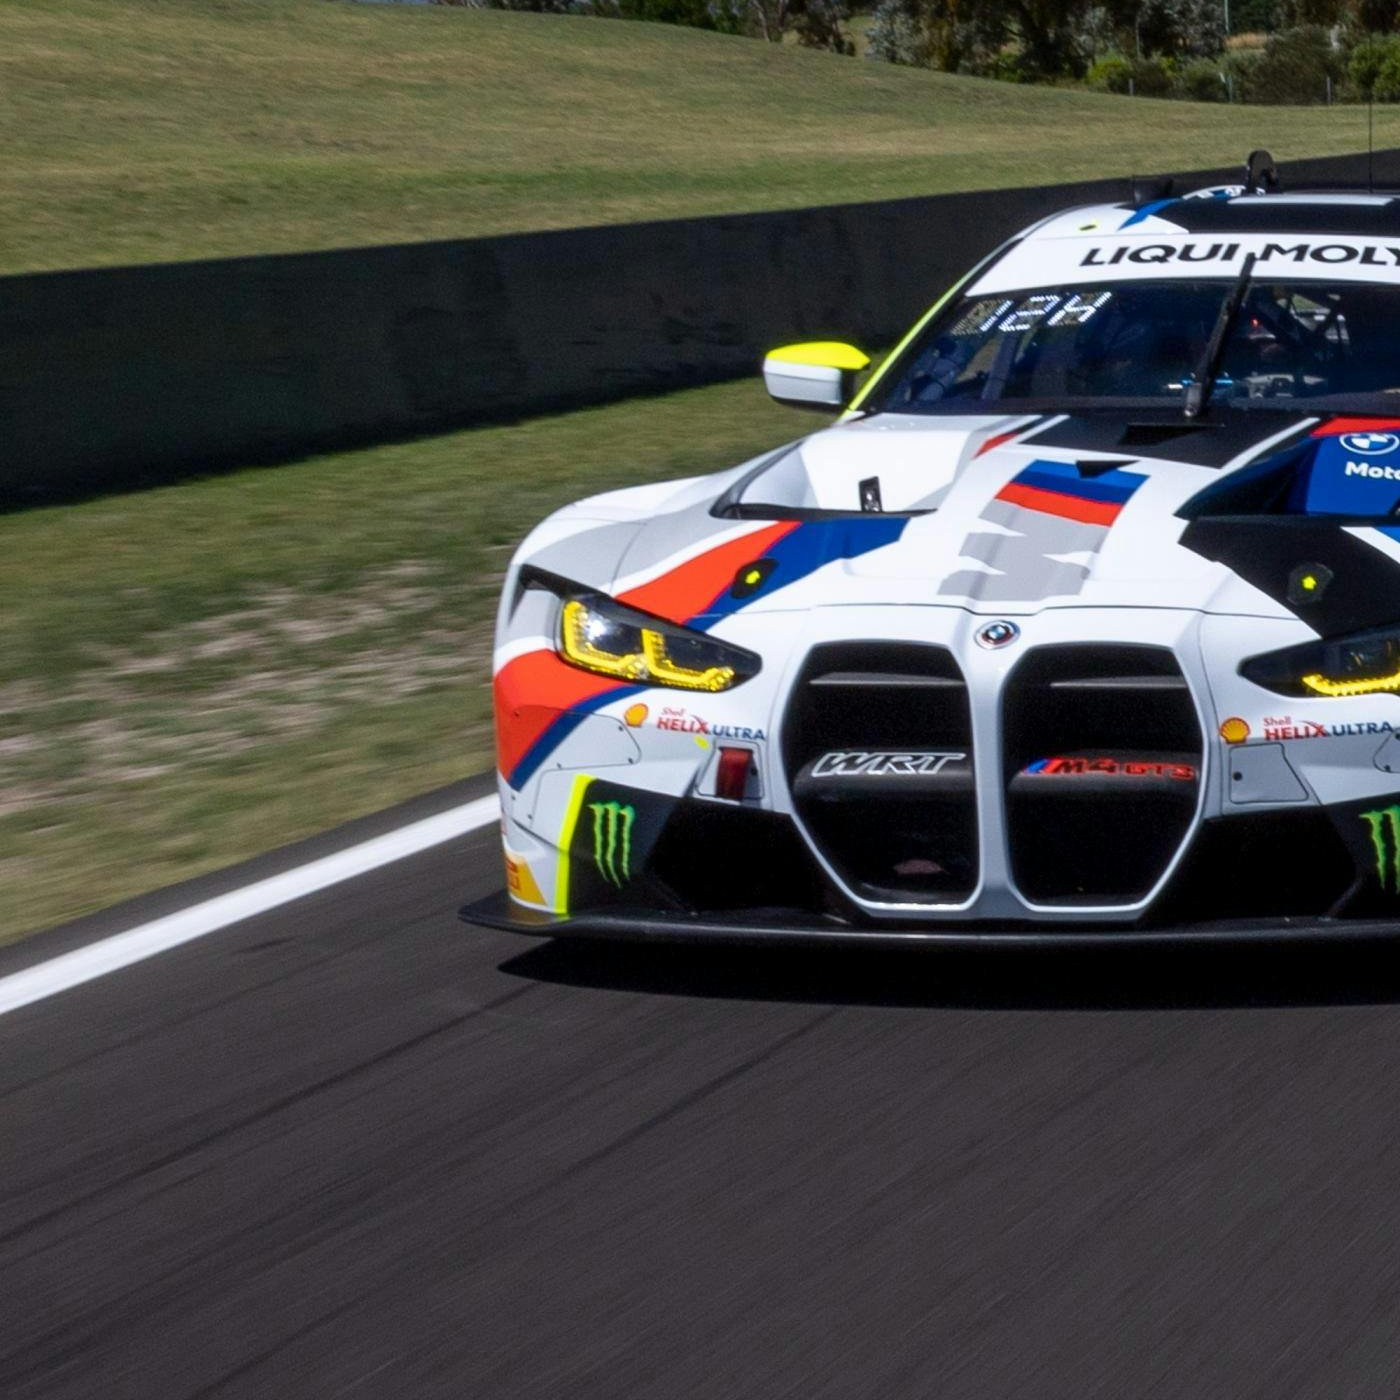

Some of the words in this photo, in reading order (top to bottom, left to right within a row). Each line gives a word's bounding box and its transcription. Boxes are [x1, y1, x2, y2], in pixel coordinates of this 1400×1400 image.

[1079, 243, 1237, 267] LIQUI
[656, 715, 710, 735] HELIX
[712, 724, 766, 740] ULTRA
[1263, 716, 1292, 727] Shell
[1263, 721, 1330, 741] HELIX
[1331, 721, 1394, 737] ULTRA
[811, 752, 967, 778] WRT
